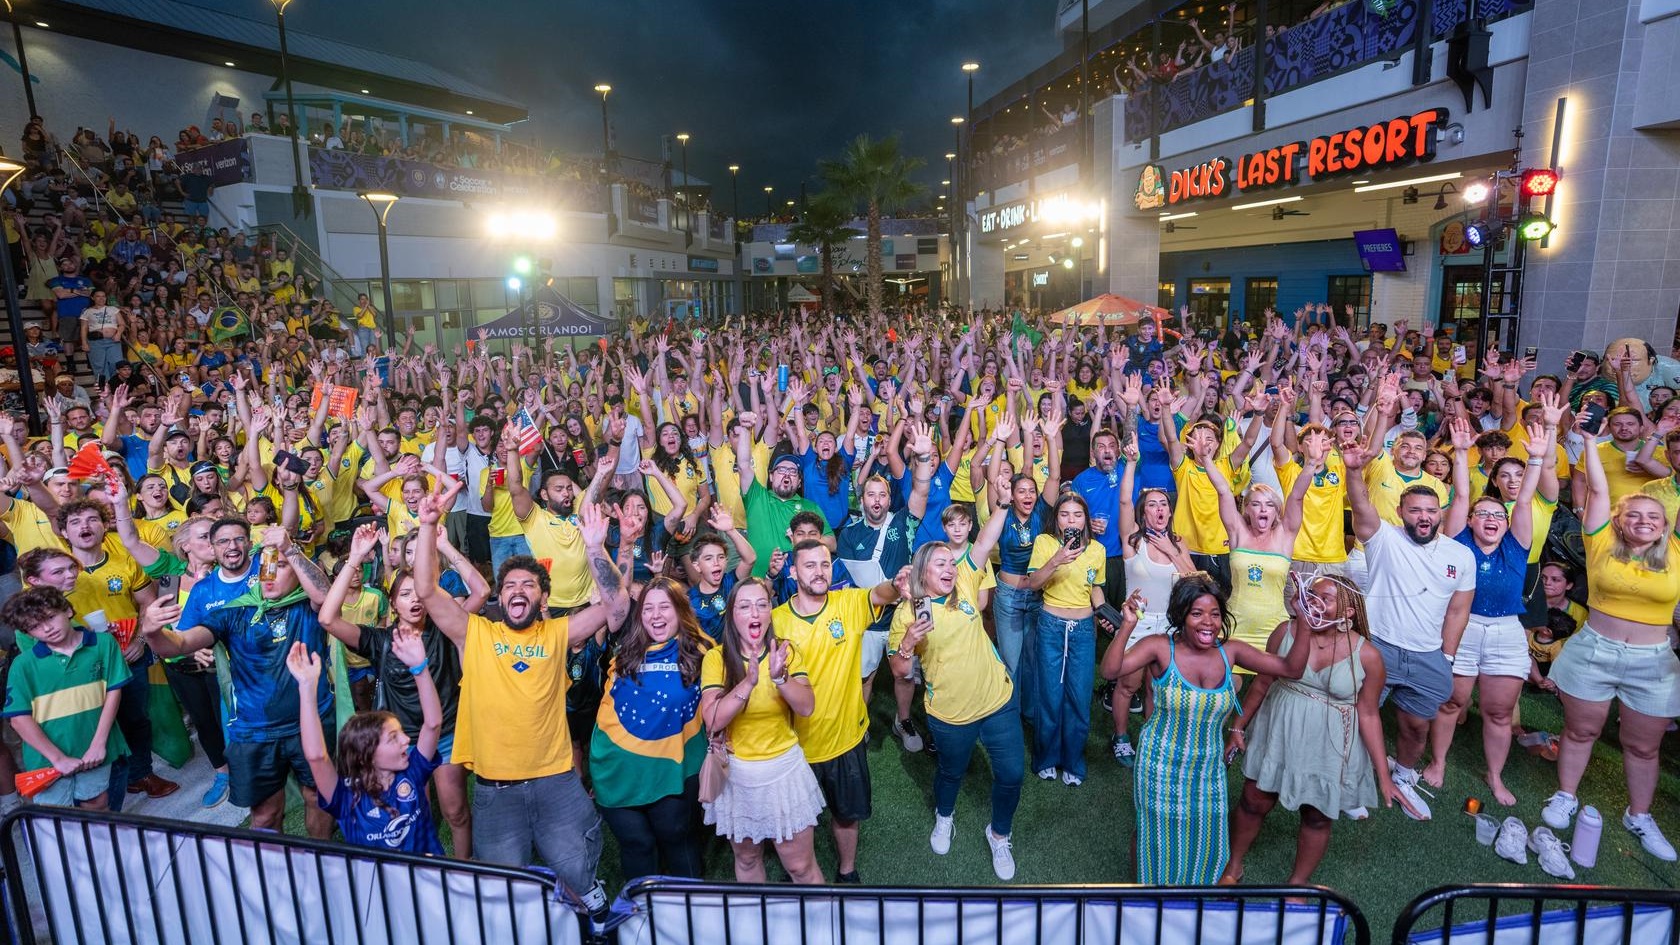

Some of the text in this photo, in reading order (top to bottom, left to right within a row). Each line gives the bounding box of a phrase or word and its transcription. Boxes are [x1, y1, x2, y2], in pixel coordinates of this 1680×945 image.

[215, 157, 238, 170] verizon
[1168, 110, 1438, 204] DICK'S LAST RESORT
[982, 212, 997, 233] EAT
[1000, 204, 1025, 230] DRINK
[528, 325, 592, 336] ORLANDO!
[493, 642, 549, 658] BRASIL
[366, 827, 405, 842] ORLANDO
